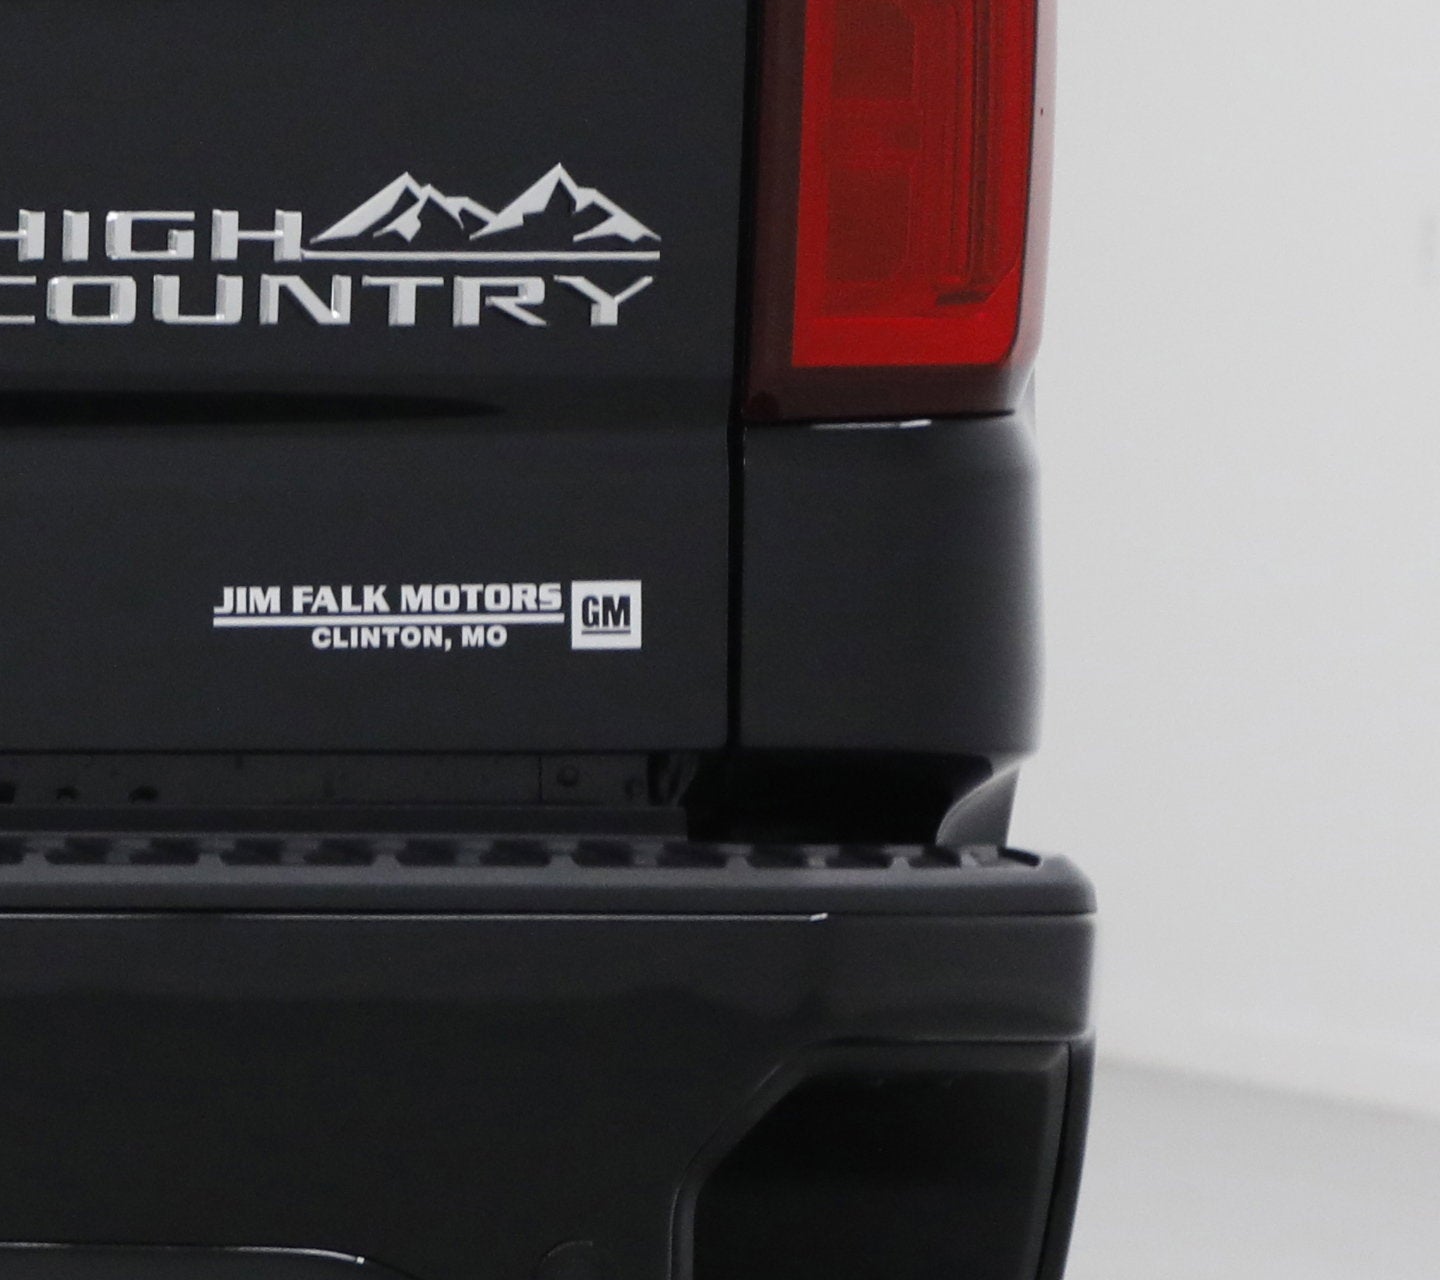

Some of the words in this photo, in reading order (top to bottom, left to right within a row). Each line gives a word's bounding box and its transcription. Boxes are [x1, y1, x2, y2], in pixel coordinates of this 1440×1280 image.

[213, 584, 281, 613] JIM
[292, 584, 390, 613] FALK
[400, 583, 562, 613] MOTORS
[581, 594, 632, 629] GM
[311, 626, 453, 651] CLINTON,
[461, 626, 508, 648] MO
